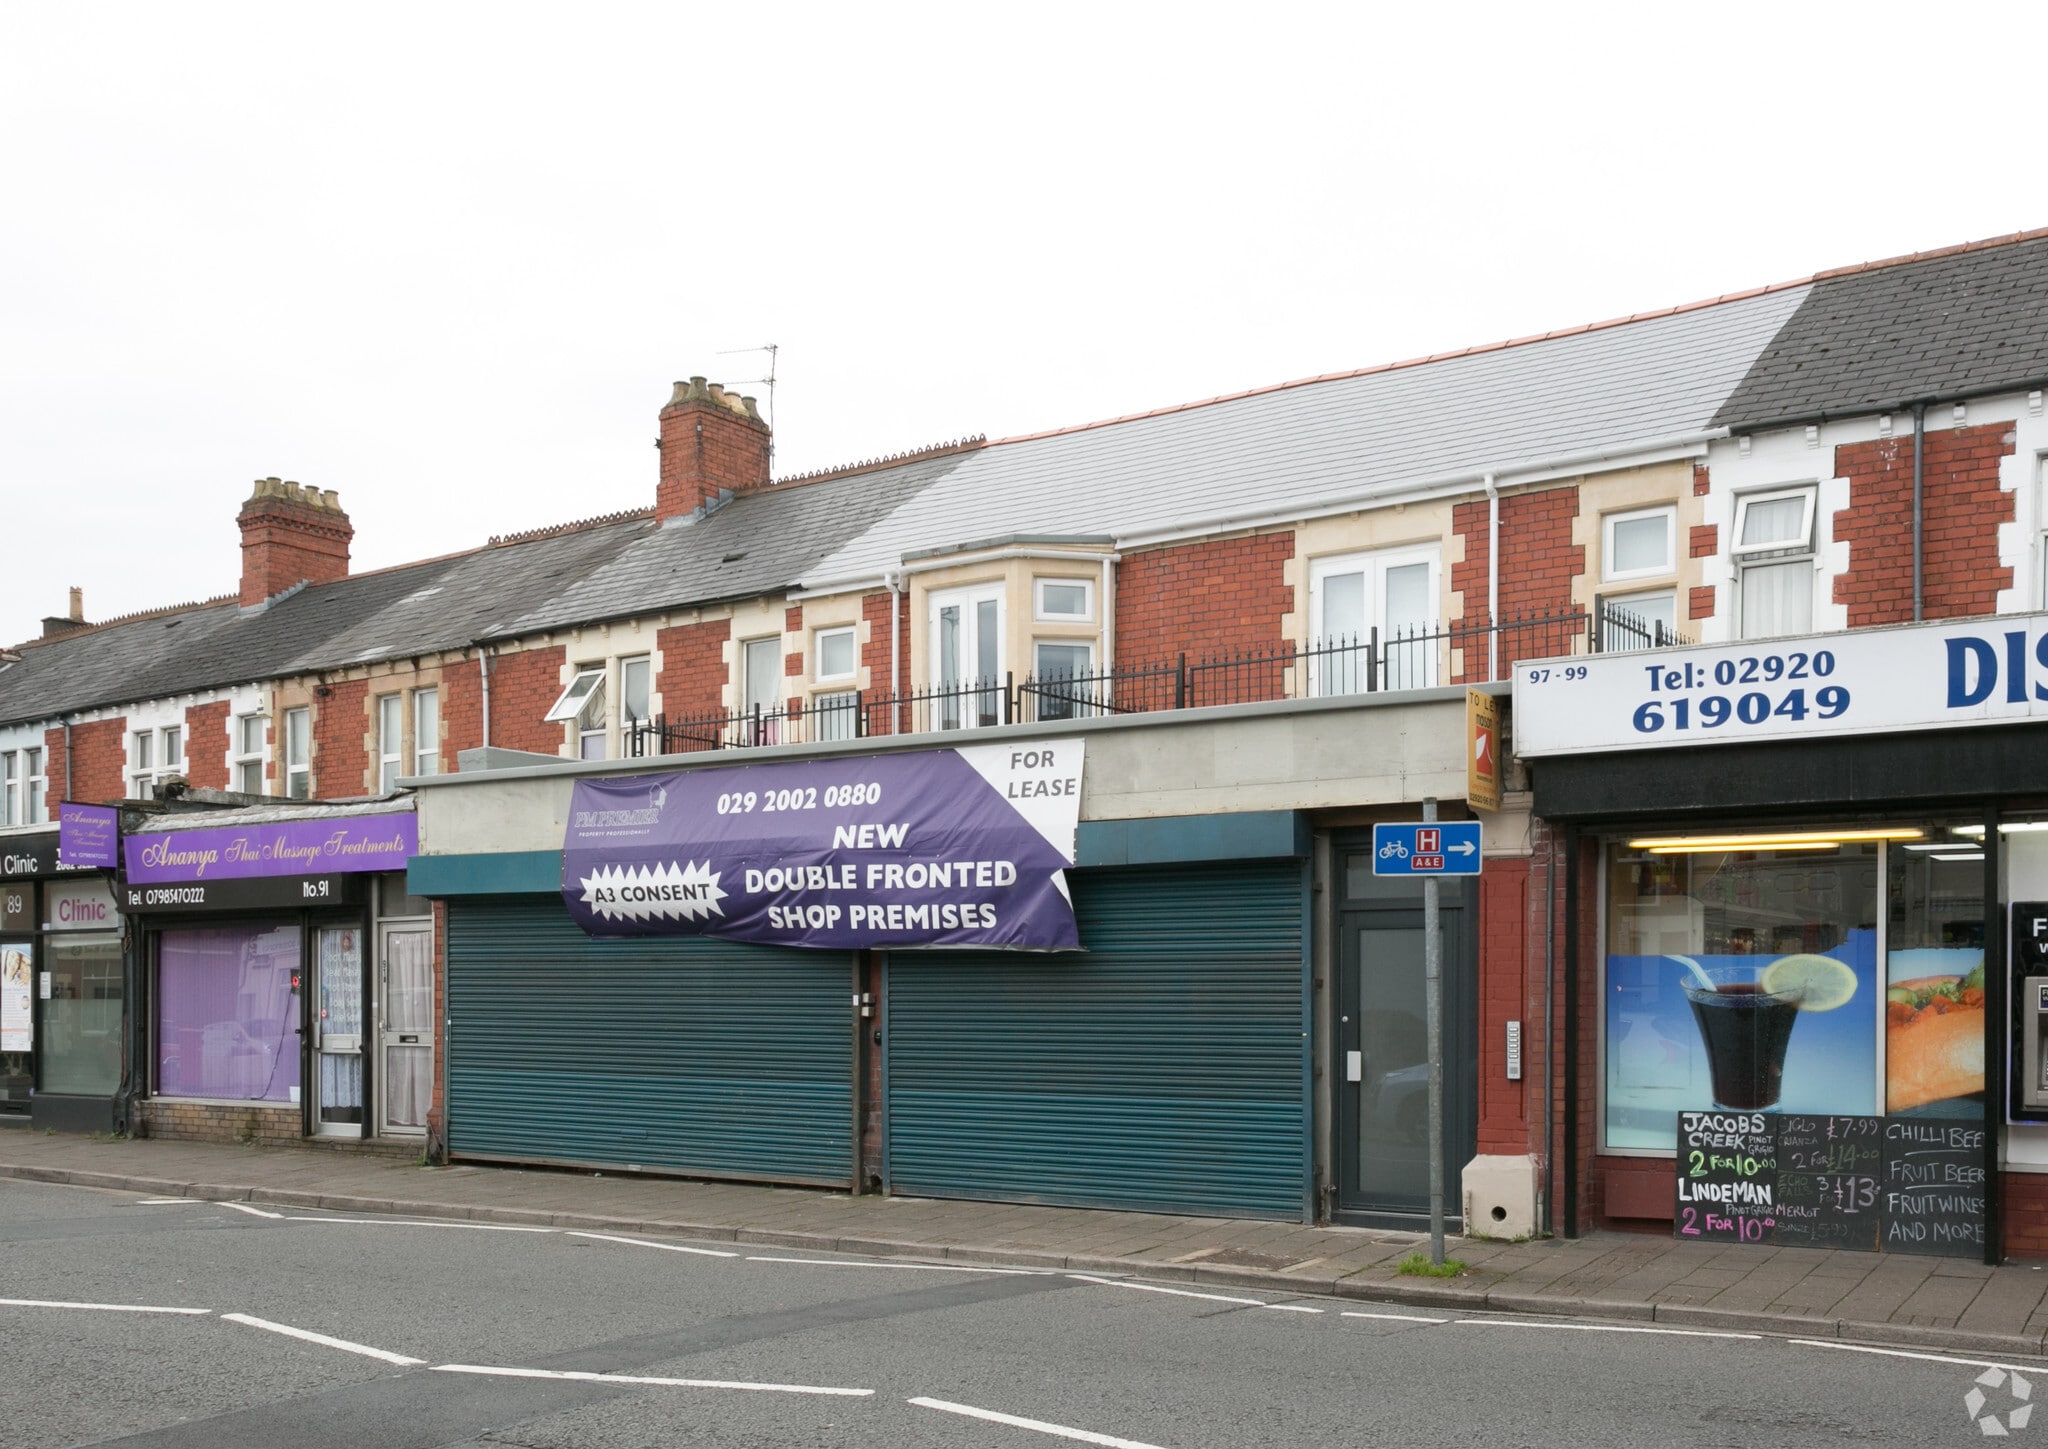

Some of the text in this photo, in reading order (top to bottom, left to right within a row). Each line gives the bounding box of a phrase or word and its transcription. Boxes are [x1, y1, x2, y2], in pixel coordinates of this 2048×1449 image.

[1645, 650, 1835, 692] Tel: 02920
[1469, 692, 1480, 706] TO
[1632, 685, 1851, 733] 619049
[1011, 750, 1055, 770] FOR
[717, 782, 881, 815] 029 2002 0880
[1008, 778, 1076, 799] LEASE
[63, 811, 112, 829] Ananya
[574, 808, 659, 828] PM PREMIER
[578, 829, 651, 838] PROPERTY PROFESSIONALLY
[832, 823, 910, 850] NEW
[1420, 831, 1437, 851] H
[4, 854, 38, 874] Clinic
[142, 831, 404, 877] Ananya Thai Massage Treatments
[745, 861, 1017, 894] DOUBLE FRONTED
[146, 888, 204, 905] 07985470222
[595, 883, 710, 903] A3 CONSENT
[7, 895, 22, 913] 89
[59, 898, 106, 922] Clinic
[768, 903, 997, 930] SHOP PREMISES
[1682, 1112, 1766, 1134] JACOBS
[1688, 1132, 1746, 1150] CREEK
[1748, 1135, 1774, 1144] PINOT
[1886, 1124, 1985, 1148] CHILLI BEE
[1747, 1145, 1775, 1156] GRIGIO
[1791, 1152, 1806, 1169] 2
[1810, 1150, 1828, 1166] FOR
[1688, 1150, 1708, 1178] 2
[1709, 1154, 1736, 1171] FOR
[1890, 1160, 1985, 1183] FRUIT BEER
[1777, 1173, 1809, 1187] ECHO
[1816, 1176, 1830, 1191] 3
[1678, 1177, 1772, 1206] LINDEMAN
[1725, 1203, 1775, 1217] PINOT GRIGIO
[1775, 1203, 1820, 1218] MERLOT
[1887, 1193, 1936, 1214] FRUIT
[1681, 1206, 1701, 1235] 2
[1706, 1213, 1734, 1231] FOR
[1888, 1220, 1985, 1244] AND MORE
